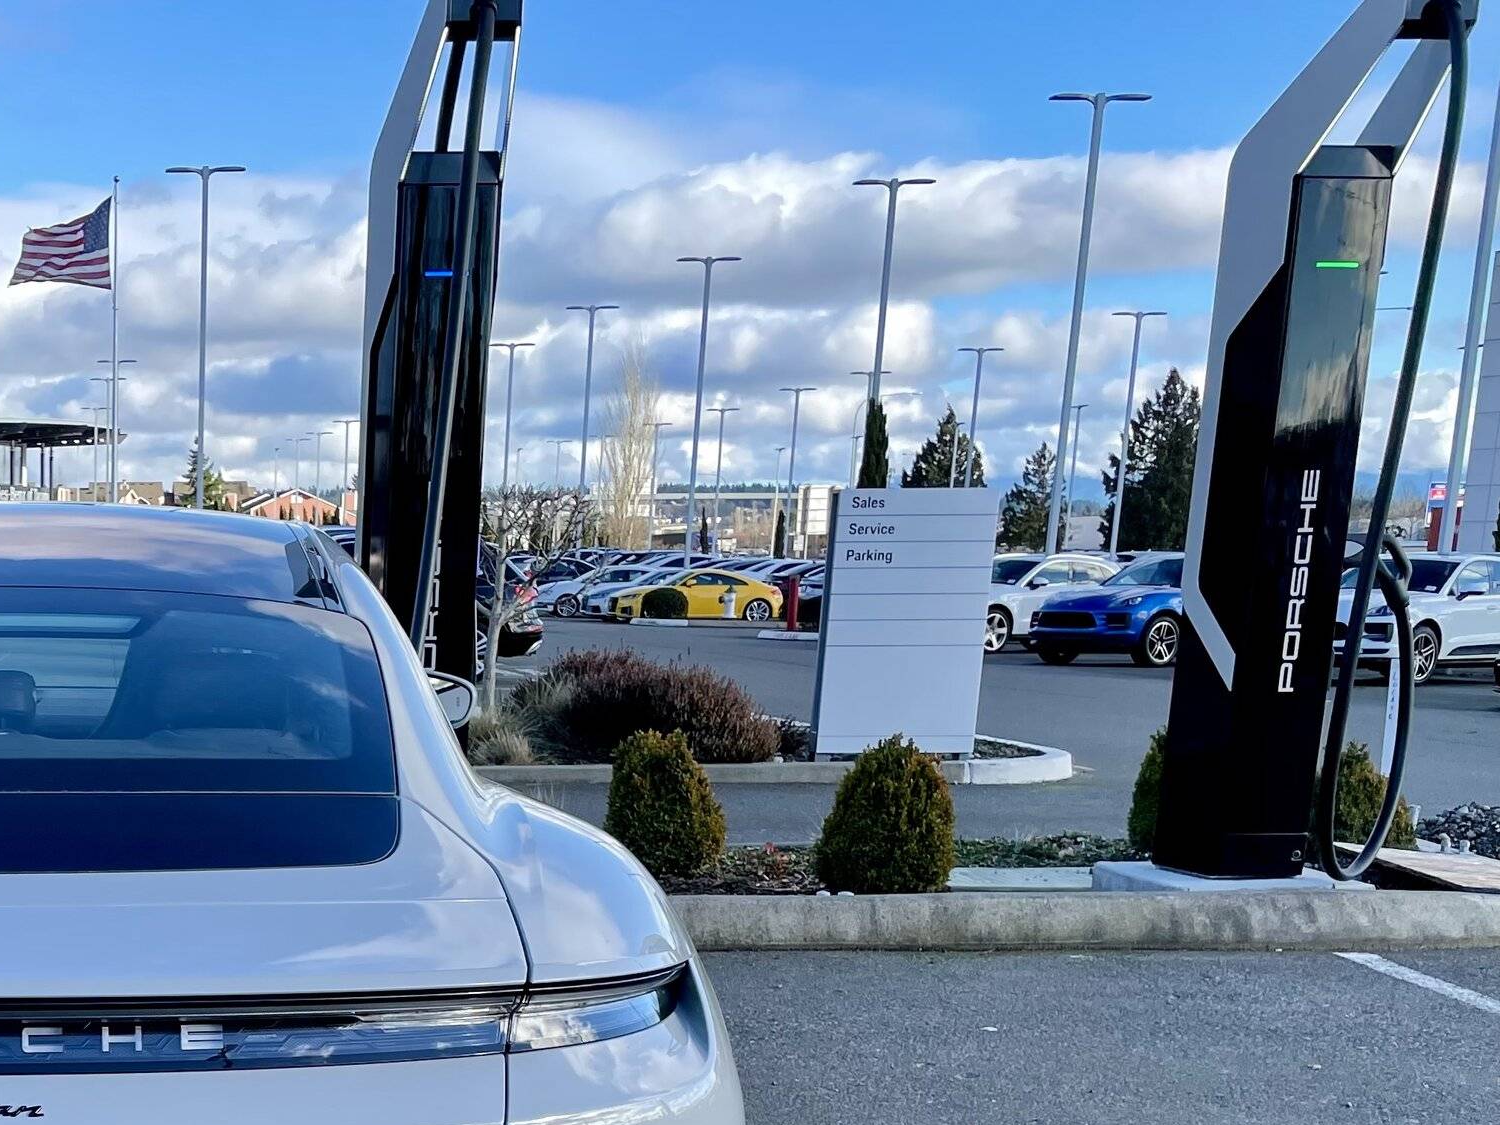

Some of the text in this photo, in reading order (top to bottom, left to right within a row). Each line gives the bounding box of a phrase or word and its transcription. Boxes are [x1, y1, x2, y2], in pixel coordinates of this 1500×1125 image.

[852, 496, 885, 508] Sales
[849, 523, 895, 535] Service
[846, 549, 893, 564] Parking
[1278, 469, 1320, 692] PORSCHE
